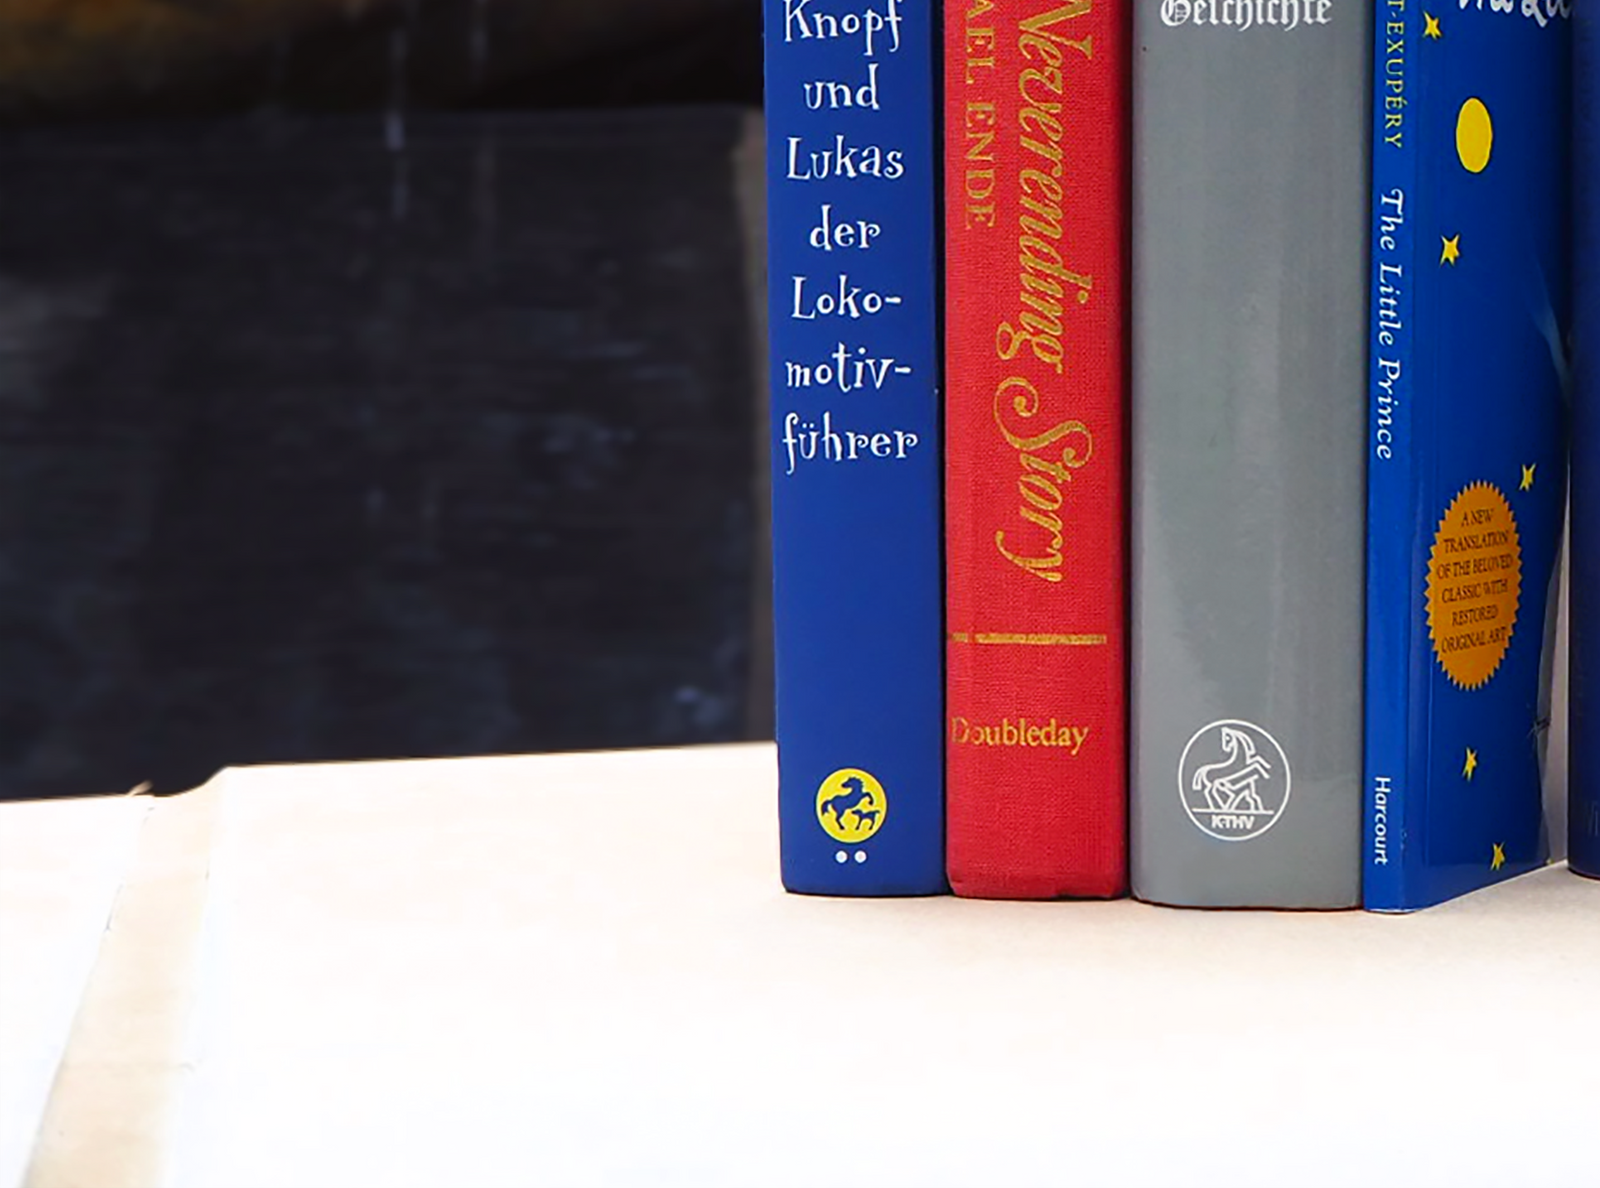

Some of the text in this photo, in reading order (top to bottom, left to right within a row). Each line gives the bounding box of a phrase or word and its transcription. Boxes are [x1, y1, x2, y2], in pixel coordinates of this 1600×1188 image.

[803, 63, 880, 110] und
[787, 134, 904, 180] Lukas
[964, 101, 996, 230] ENDE
[809, 204, 881, 251] der
[791, 274, 902, 320] Loko-
[1376, 188, 1404, 459] The Little Prince
[785, 342, 912, 393] motiv-
[782, 411, 918, 475] führer
[993, 377, 1093, 583] Story
[1460, 508, 1495, 527] A NEW
[1443, 530, 1509, 554] TRANSLATION
[1437, 554, 1513, 579] OF THE BELOVED
[1441, 579, 1508, 603] CLASSIC WITH
[1452, 604, 1499, 626] RESTORED
[1441, 627, 1508, 653] ORIGINAL ART
[951, 717, 1089, 756] Doubleday
[1373, 776, 1391, 865] Harcourt
